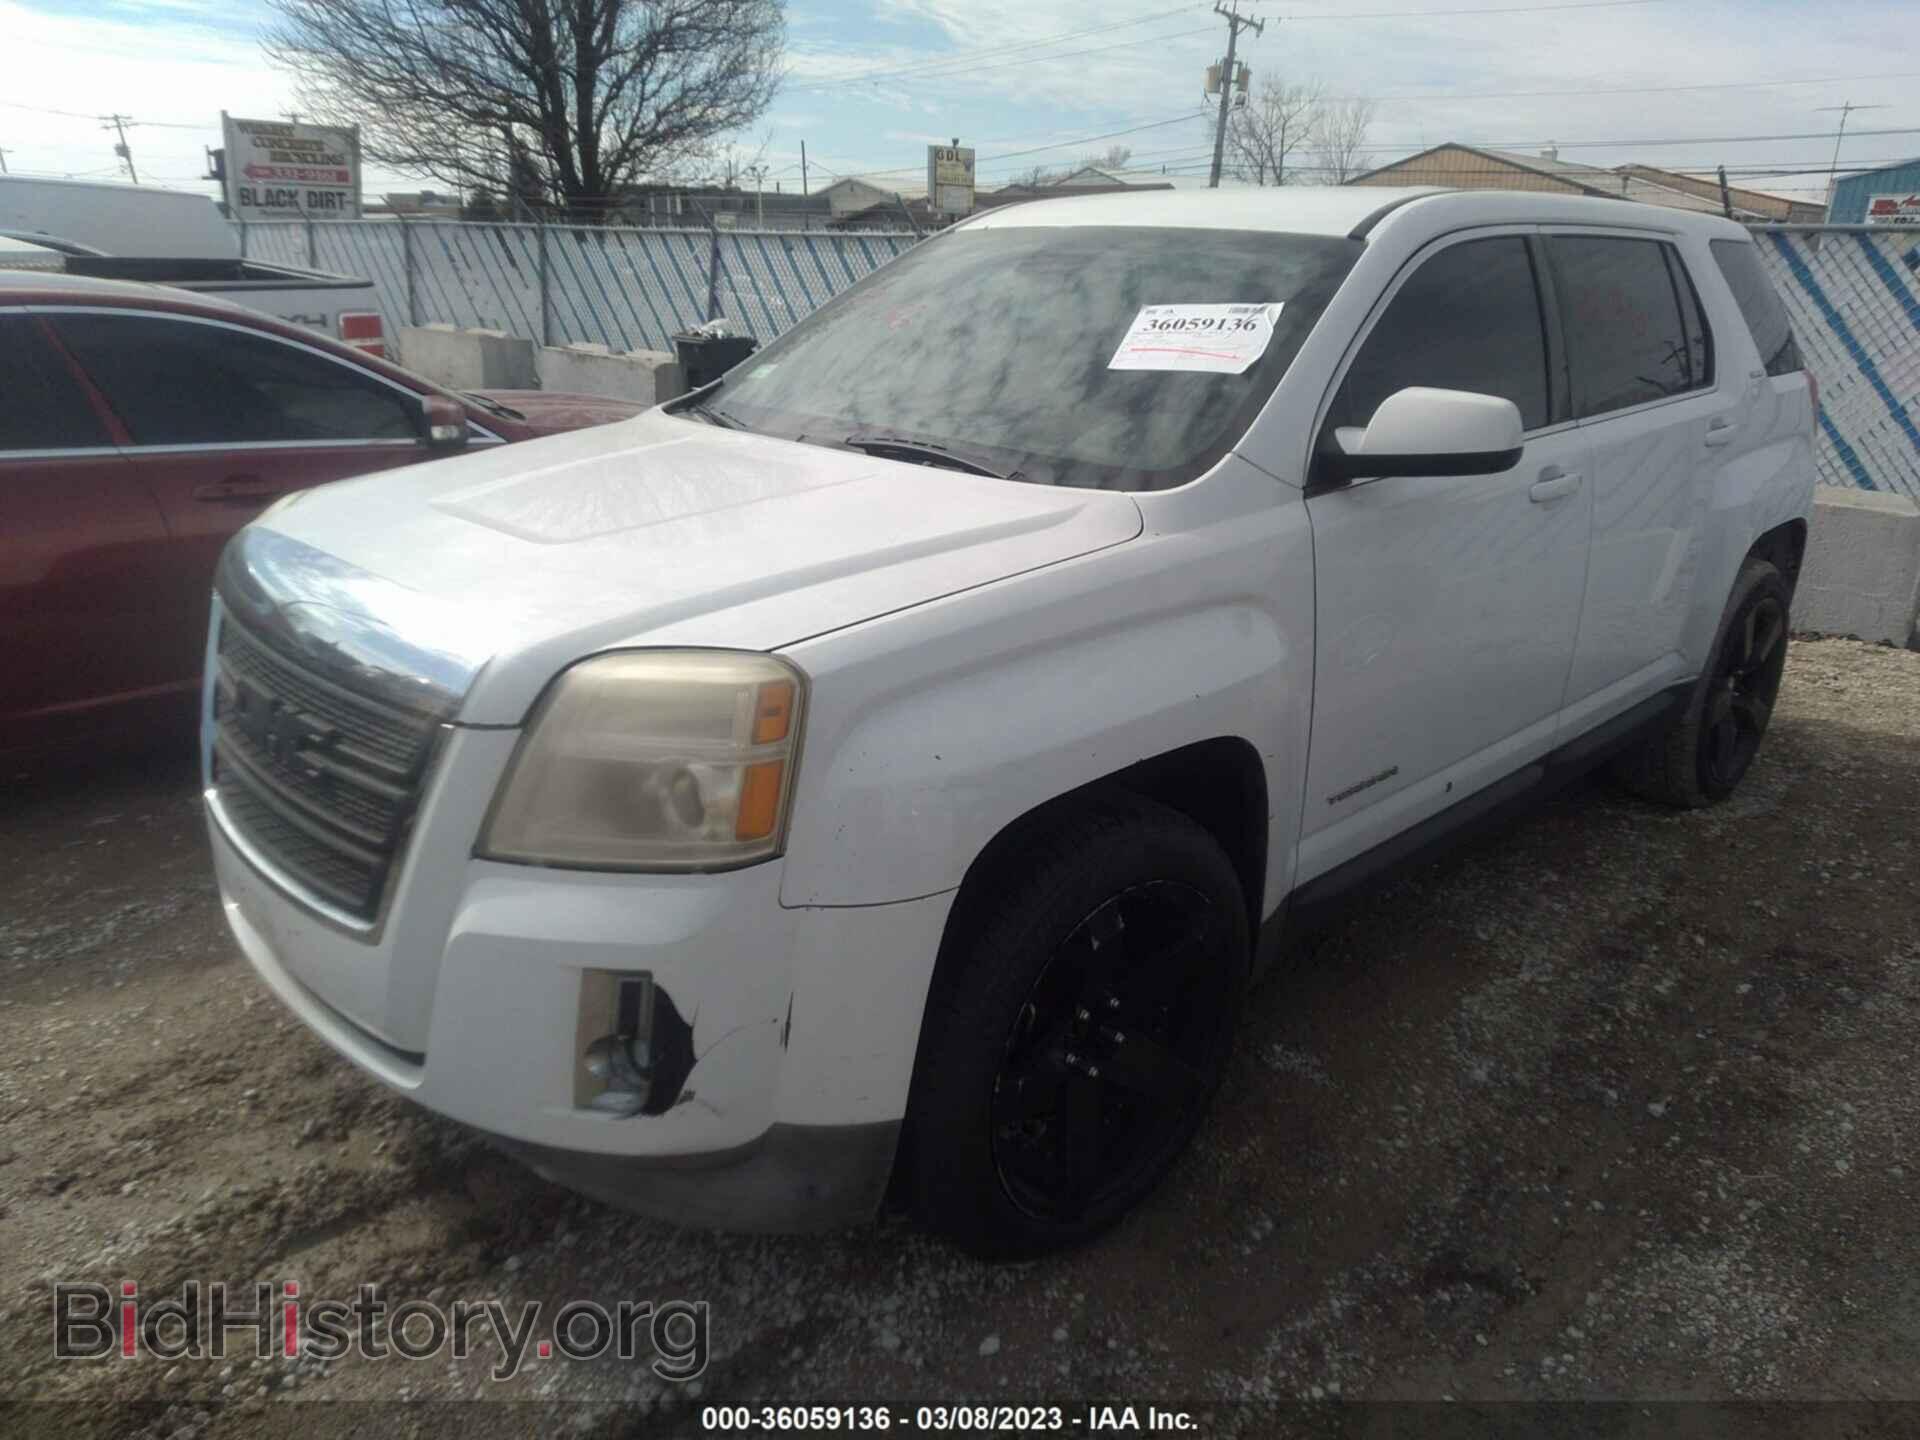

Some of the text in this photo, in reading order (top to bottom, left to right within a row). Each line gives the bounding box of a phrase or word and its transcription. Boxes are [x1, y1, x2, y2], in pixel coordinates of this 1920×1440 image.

[240, 187, 346, 210] BLACK DIRT
[1143, 317, 1257, 332] 36059136
